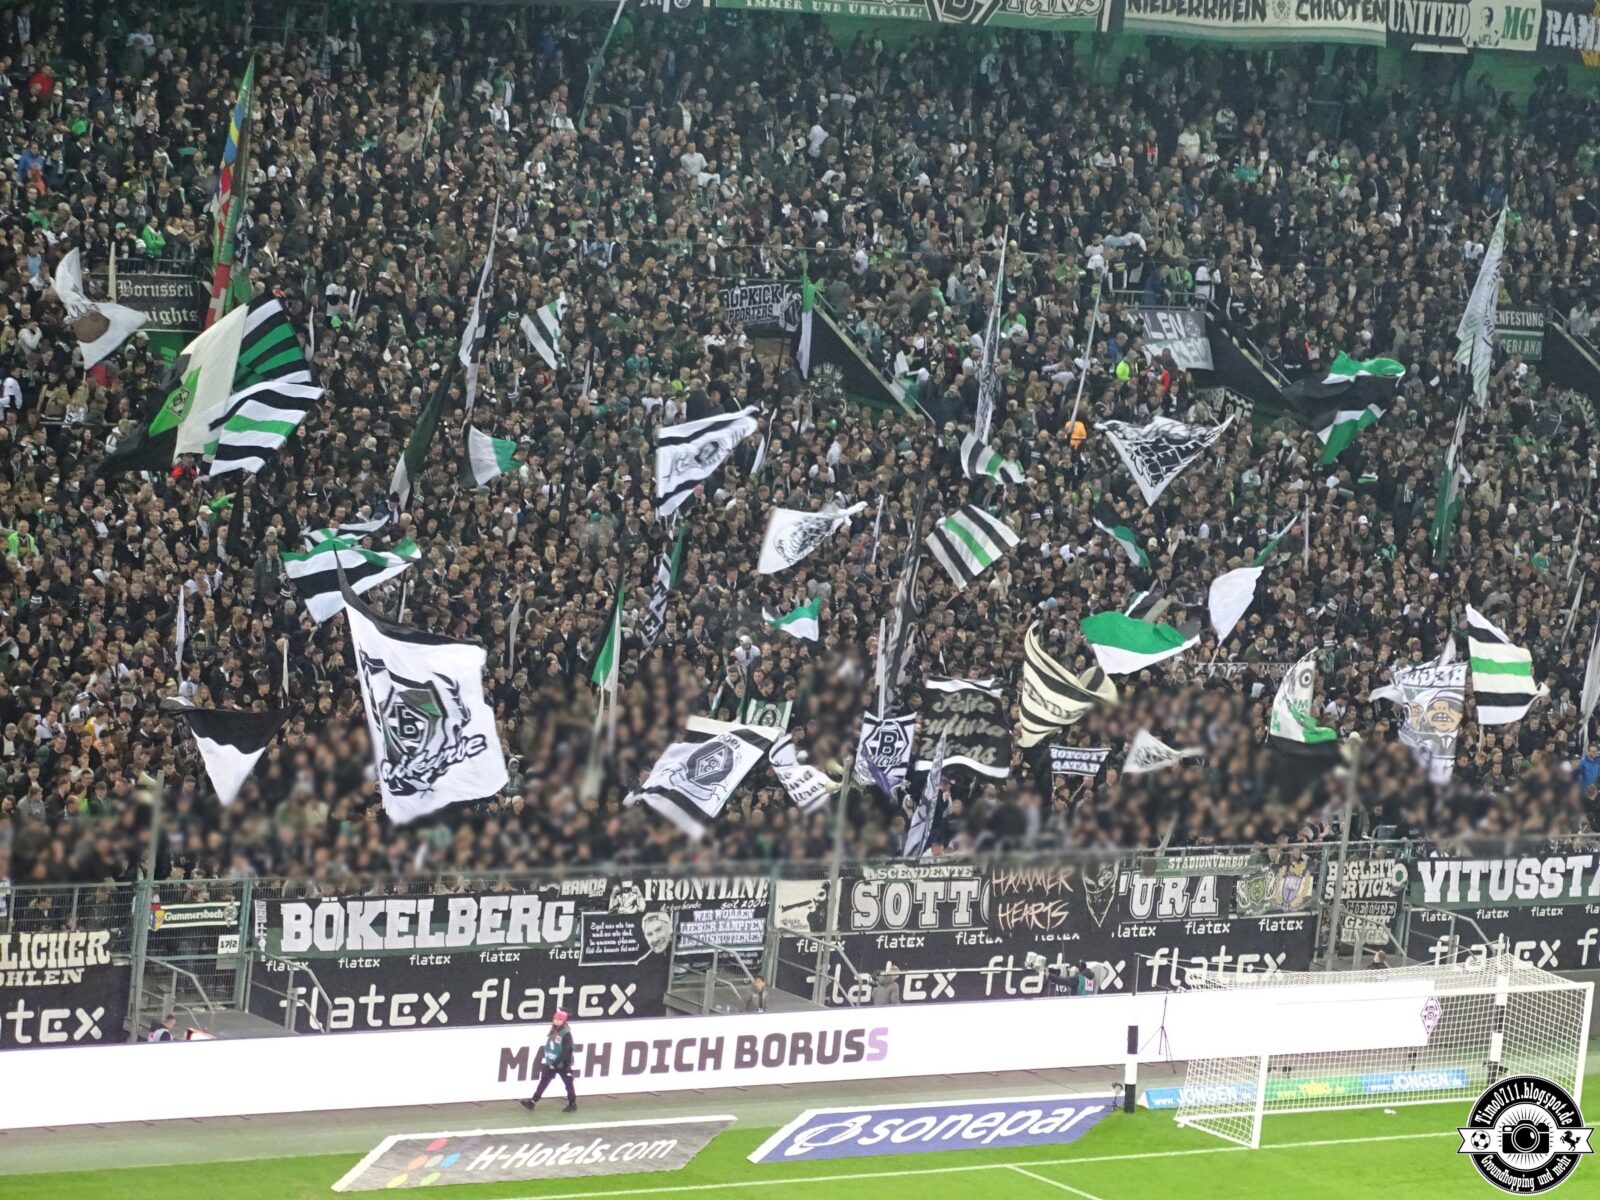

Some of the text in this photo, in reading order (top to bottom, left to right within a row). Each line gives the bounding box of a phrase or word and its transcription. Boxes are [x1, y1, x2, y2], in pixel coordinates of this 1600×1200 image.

[812, 1, 841, 13] UND
[1126, 0, 1268, 23] NIEDERRHEIN
[1388, 0, 1470, 37] UNITED
[1502, 5, 1537, 42] MG
[118, 279, 194, 298] Borussen
[1050, 748, 1110, 762] BOYCOTT
[1167, 855, 1250, 871] STADIONVERBOT
[866, 864, 974, 880] ASCENDENTE
[643, 876, 770, 901] FRONTLINE
[164, 909, 224, 922] Gummersbach
[714, 908, 754, 920] WOLLEN
[998, 899, 1070, 932] HEARTS
[1475, 908, 1510, 920] flatex
[1531, 906, 1564, 918] flatex
[280, 896, 575, 953] BÖKELBERG
[1185, 921, 1232, 936] flatex
[1258, 918, 1304, 933] flatex
[220, 940, 238, 951] 17/2
[875, 935, 926, 949] flatex
[338, 956, 381, 969] flatex
[409, 954, 451, 966] flatex
[479, 951, 521, 963] flatex
[472, 975, 637, 1022] flatex
[621, 1036, 725, 1076] DICH
[733, 1026, 889, 1070] BORUSS
[1392, 1072, 1450, 1092] JONGEN
[858, 1105, 1105, 1145] sonepar
[465, 1138, 679, 1172] H-Hotels.com
